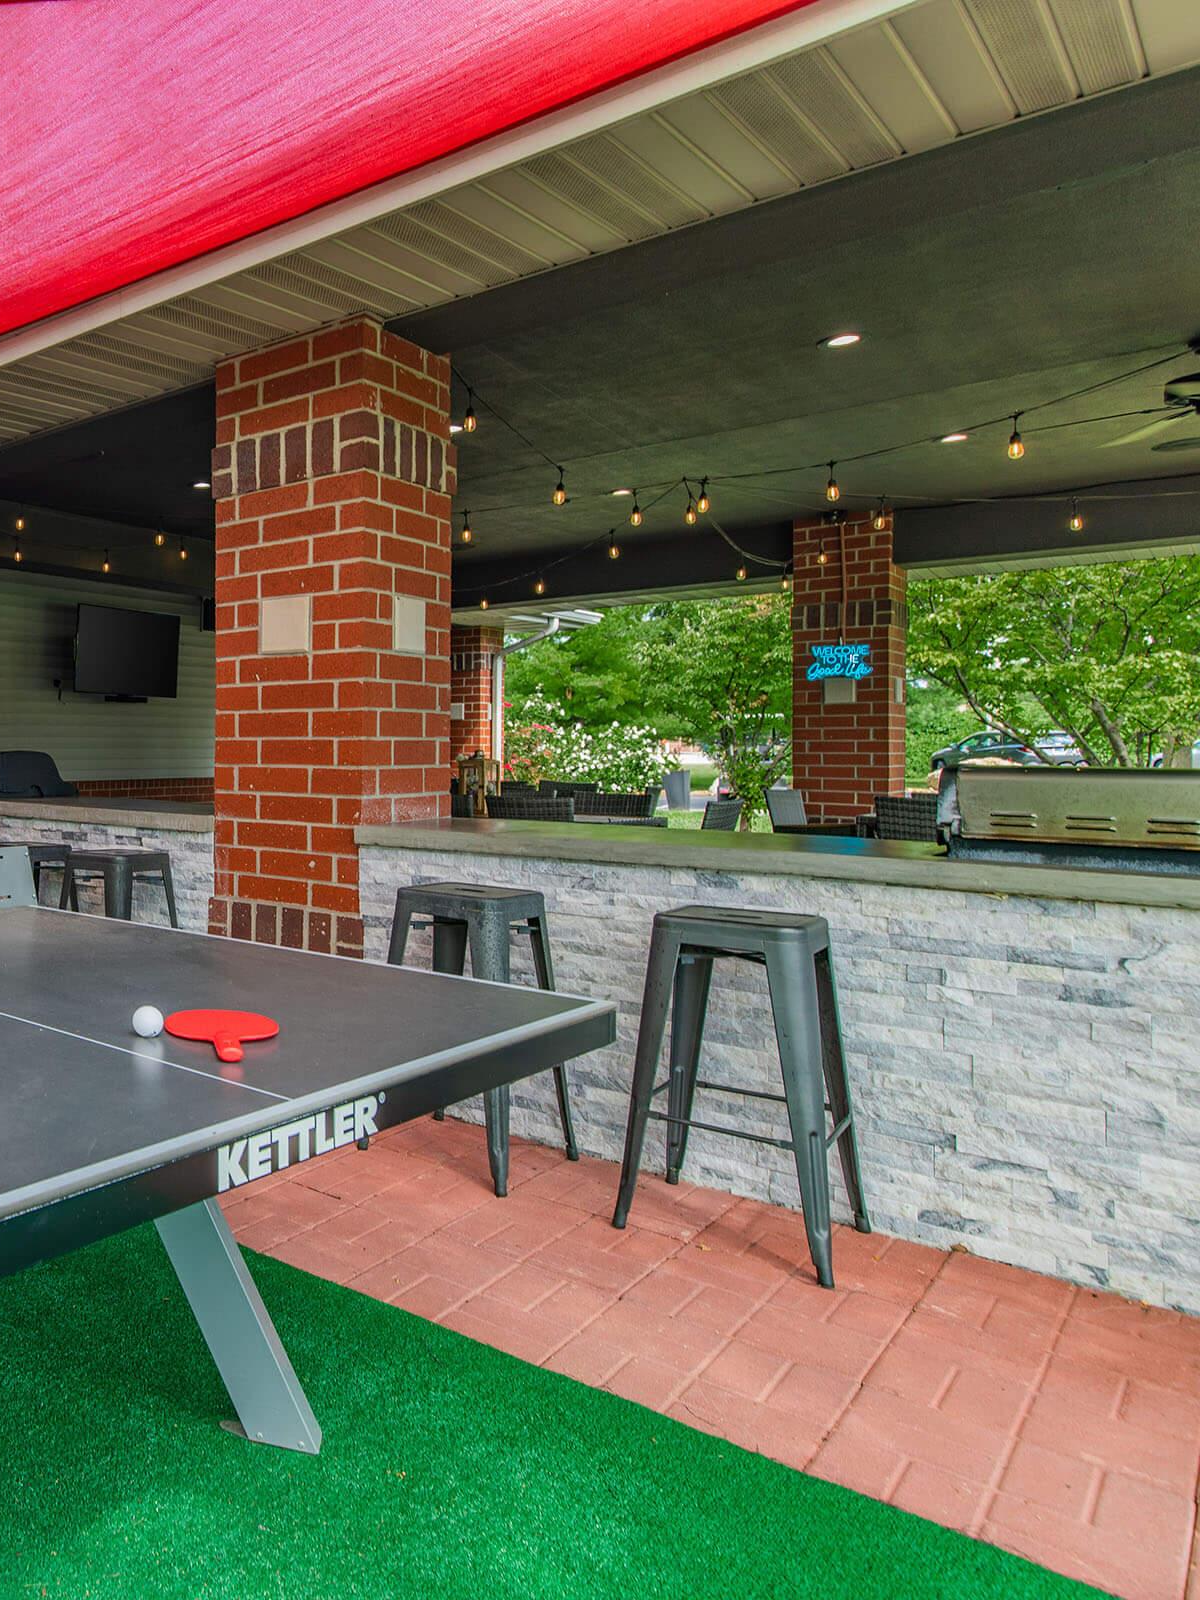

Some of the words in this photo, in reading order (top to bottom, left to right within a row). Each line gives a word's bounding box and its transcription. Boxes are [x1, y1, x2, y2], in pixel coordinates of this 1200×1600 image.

[811, 645, 869, 657] WELCOME
[822, 655, 837, 664] TO
[838, 654, 860, 664] THE
[807, 662, 844, 680] Good
[217, 1095, 379, 1193] KETTLER
